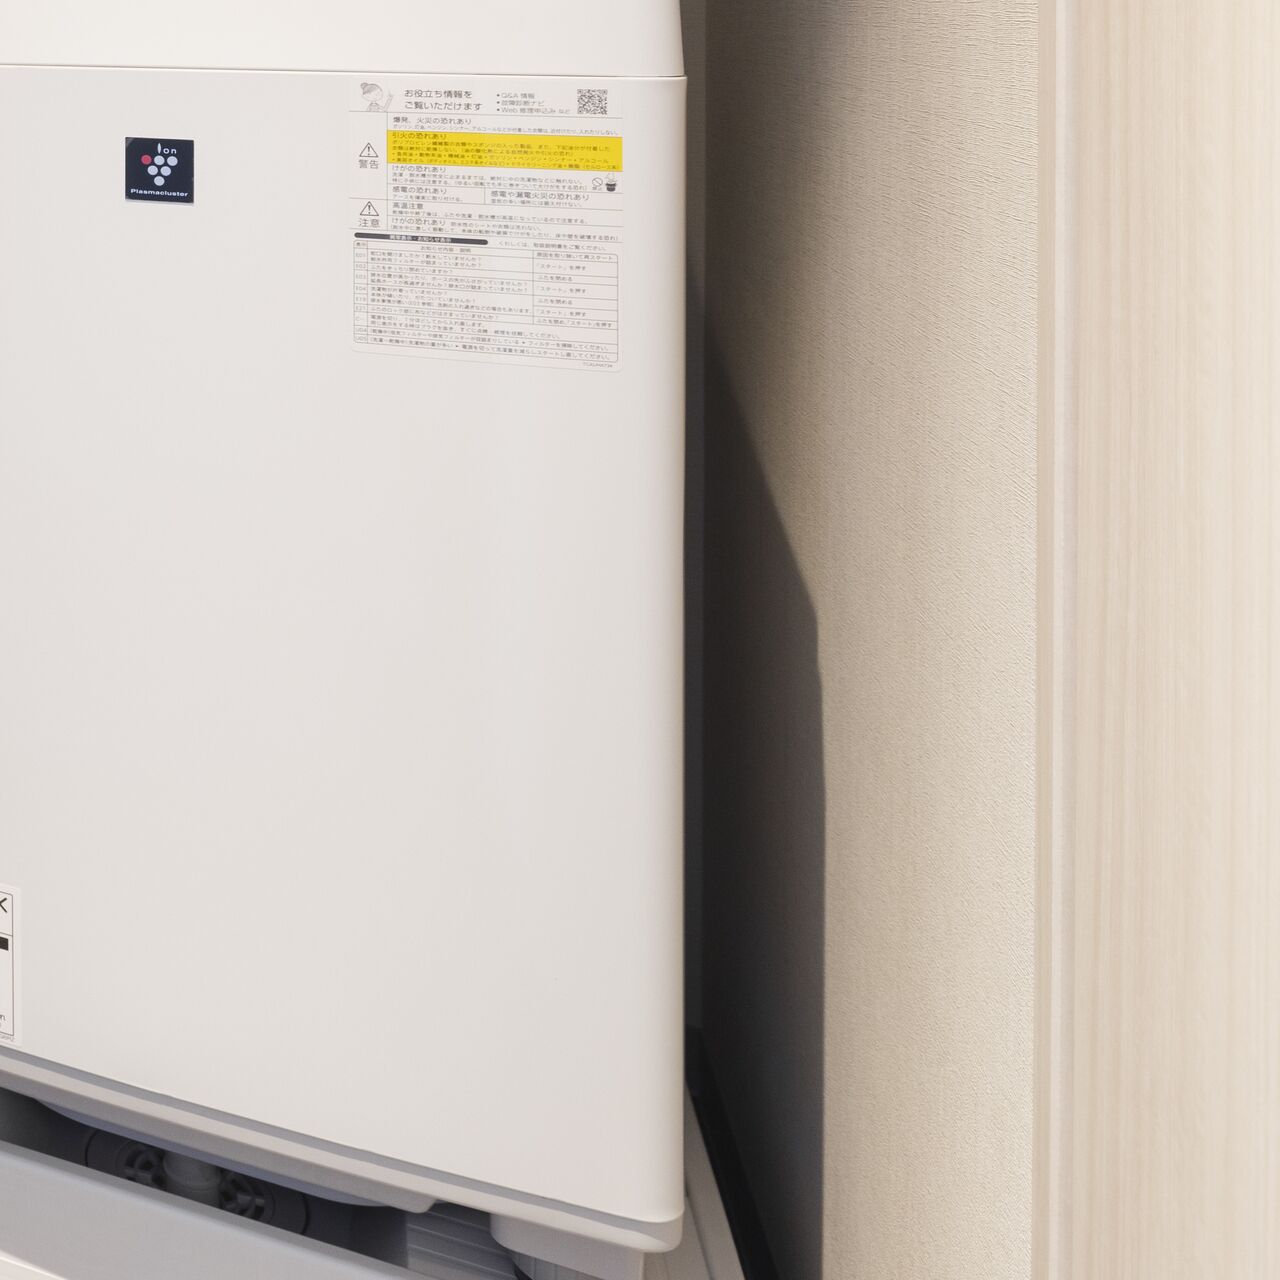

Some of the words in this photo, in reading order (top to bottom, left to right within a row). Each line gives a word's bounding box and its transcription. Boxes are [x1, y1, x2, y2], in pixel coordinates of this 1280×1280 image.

[404, 89, 472, 99] お役立ち情報を
[404, 101, 482, 111] ご覧いただけます
[392, 132, 447, 140] 引火の恐れあり
[358, 159, 379, 169] 警告
[392, 165, 447, 173] けがの恐れあり
[130, 188, 189, 197] Plasmacluster
[392, 186, 447, 195] 感電の恐れあり
[491, 190, 590, 201] 感電や漏電火災の恐れあり
[393, 202, 424, 210] 高温注意
[359, 218, 380, 227] 注意
[392, 218, 446, 227] けがの恐れあり
